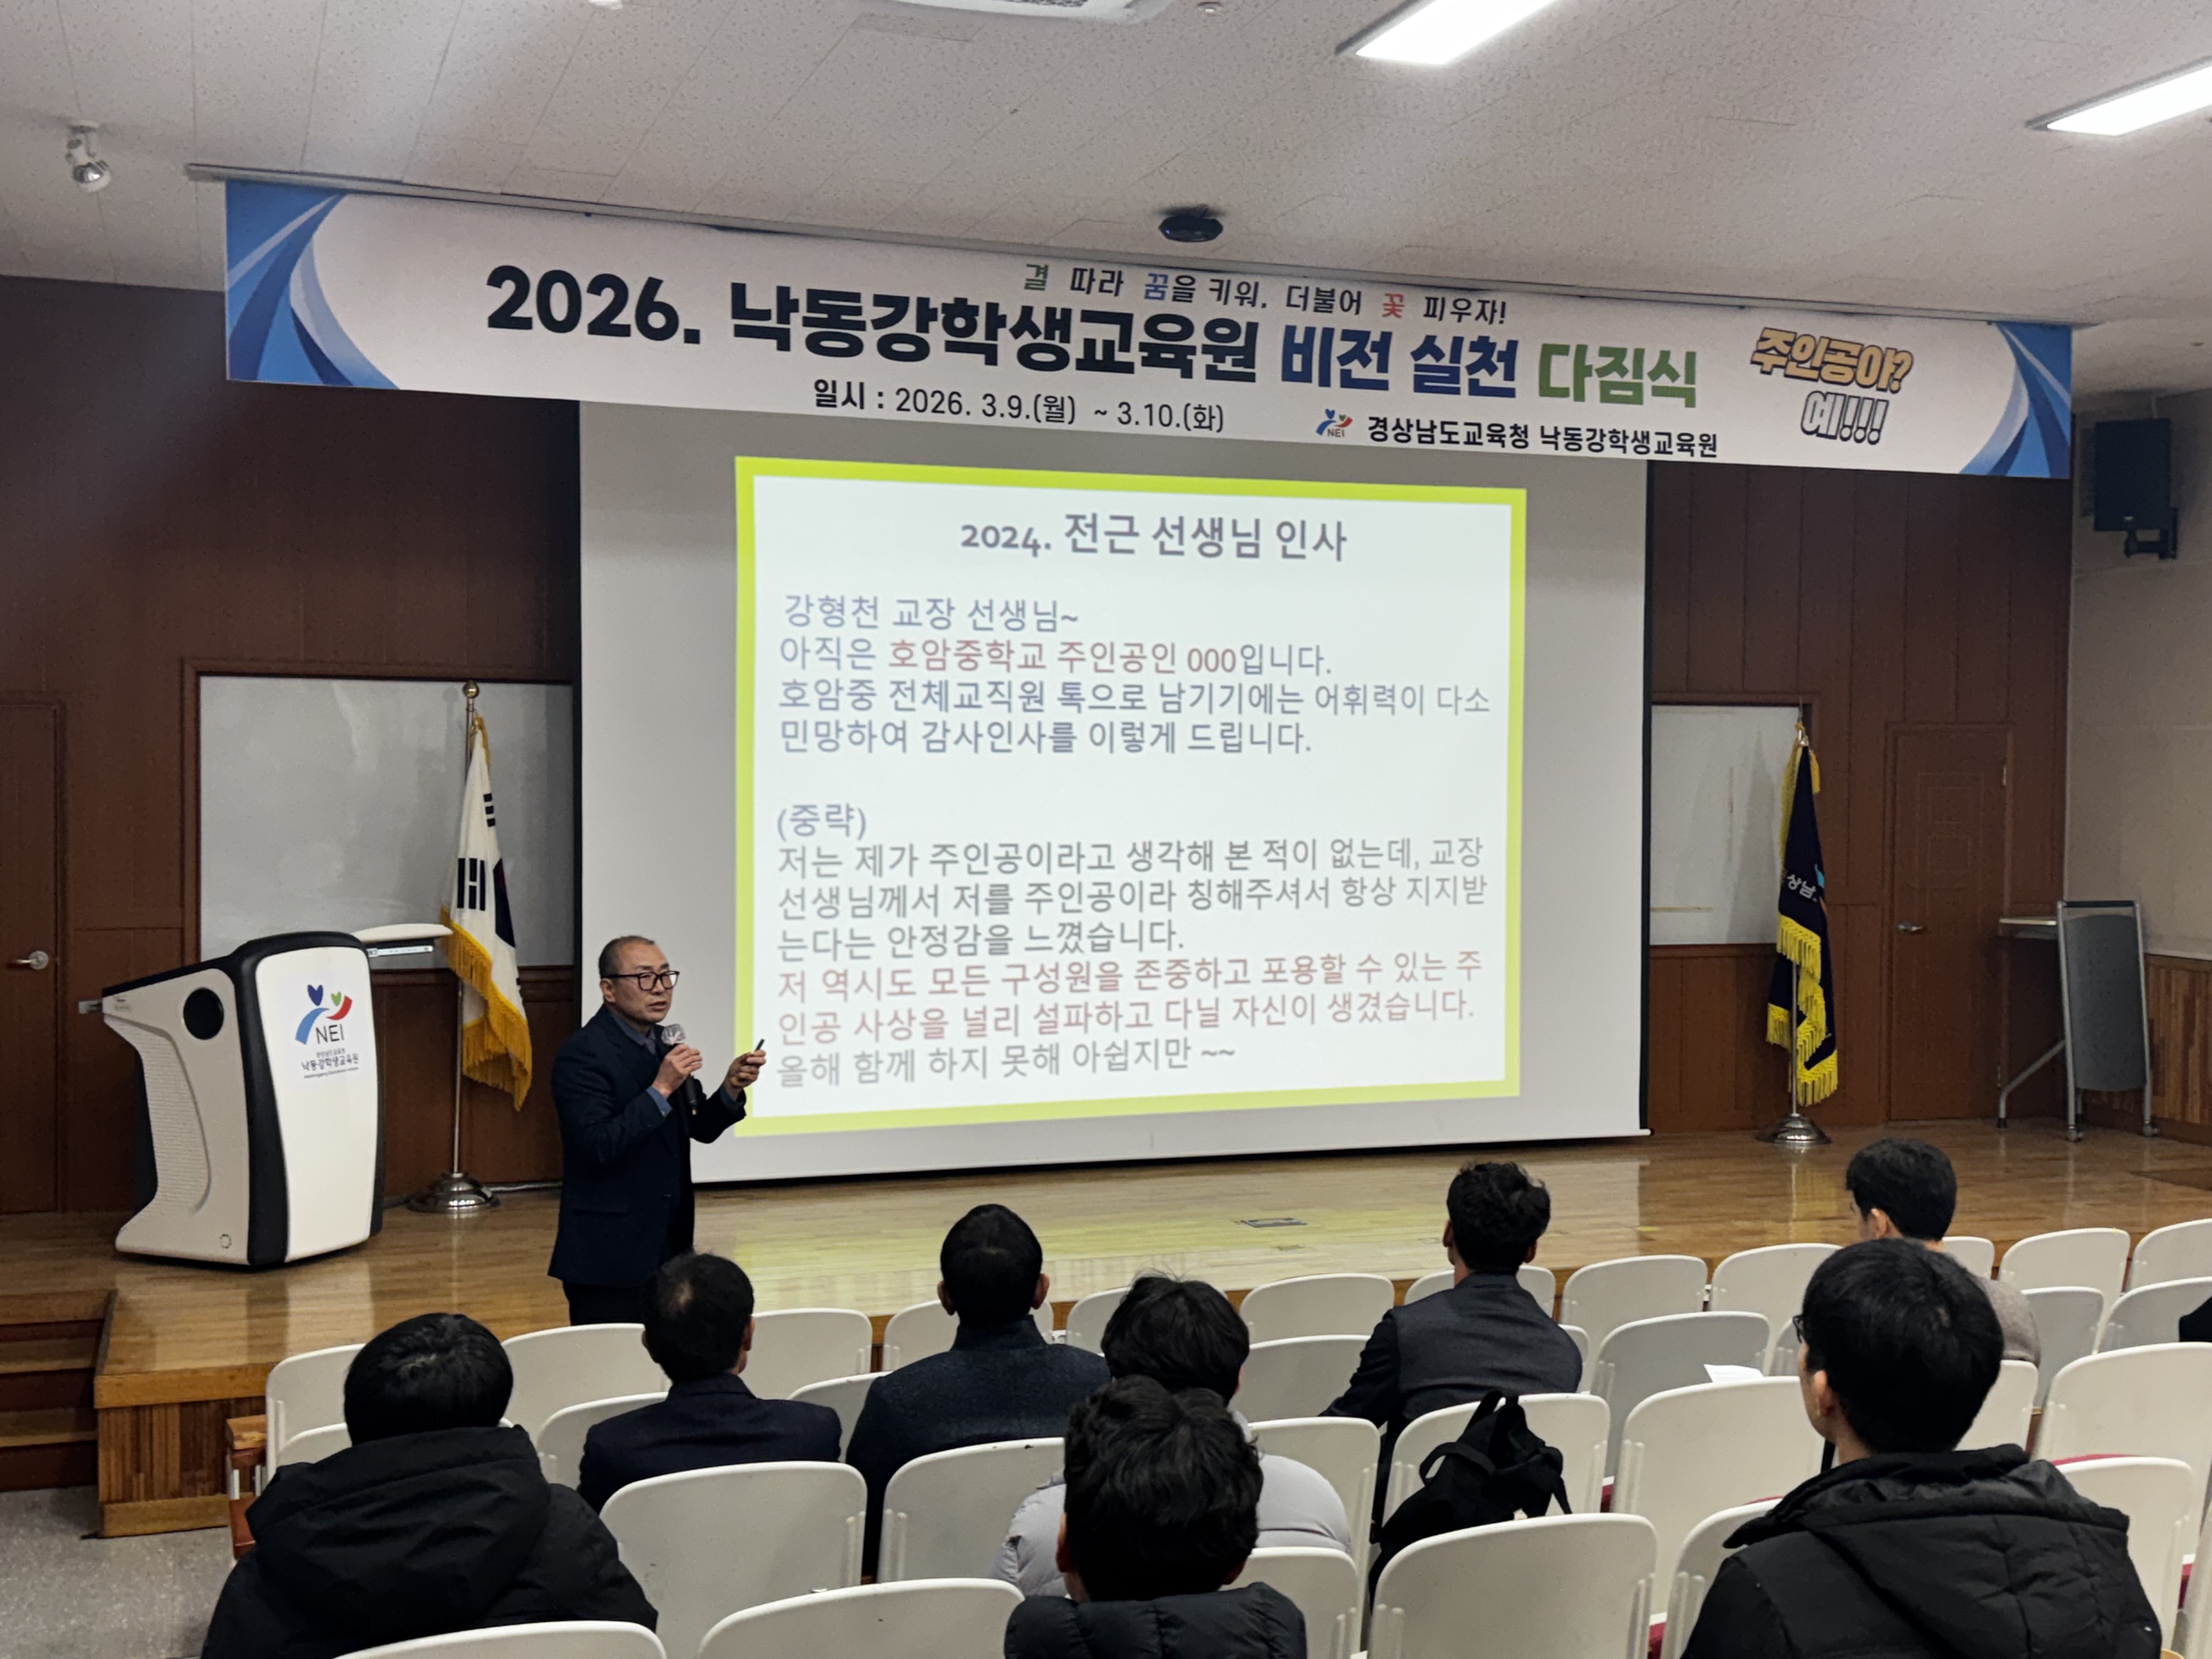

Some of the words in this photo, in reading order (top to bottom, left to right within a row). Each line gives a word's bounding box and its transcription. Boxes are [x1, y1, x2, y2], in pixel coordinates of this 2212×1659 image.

[1024, 263, 1049, 291] 결
[1070, 267, 1124, 297] 따라
[1144, 273, 1196, 303] 꿈을
[1286, 285, 1362, 315] 더불어
[1382, 292, 1405, 319] 꽃
[1423, 296, 1506, 325] 피우자!
[486, 264, 701, 345] 2026.
[730, 281, 1259, 383] 낙동강학생교육원
[1281, 325, 1390, 392] 비전
[1409, 334, 1519, 398] 실천
[1538, 342, 1697, 409] 다짐식
[1751, 327, 1913, 393] 주인공야?
[814, 379, 865, 410] 일시
[895, 387, 970, 416] 2026.
[981, 393, 1075, 425] 3.9.(월)
[1118, 401, 1223, 433] 3.10.(화)
[1800, 390, 1889, 445] 예!!!
[1327, 428, 1345, 438] NEI
[1367, 416, 1530, 450] 경상남도교육청
[1540, 426, 1718, 459] 낙동강학생교육원
[961, 524, 1051, 558] 2024.
[1064, 512, 1140, 555] 전근
[1152, 515, 1260, 559] 선생님
[1276, 520, 1347, 562] 인사
[785, 594, 878, 629] 강형천
[892, 597, 956, 630] 교장
[967, 599, 1079, 633] 선생님~
[780, 636, 877, 671] 아직은
[888, 638, 1047, 673] 호암중학교
[1057, 641, 1176, 674] 주인공인
[778, 678, 877, 712] 호암중
[889, 679, 1045, 714] 전체교직원
[1057, 681, 1147, 714] 톡으로
[1160, 682, 1304, 715] 남기기에는
[1315, 684, 1424, 716] 어휘력이
[1437, 685, 1490, 716] 다소
[781, 719, 907, 754] 민망하여
[922, 720, 1077, 754] 감사인사를
[1089, 721, 1175, 754] 이렇게
[1187, 721, 1311, 754] 드립니다.
[777, 803, 866, 842] (중략)
[778, 845, 843, 879] 저는
[855, 843, 919, 878] 제가
[929, 841, 1116, 877] 주인공이라고
[1126, 839, 1213, 873] 생각해
[1224, 840, 1252, 871] 본
[1262, 838, 1317, 871] 적이
[1330, 837, 1419, 871] 없는데,
[1429, 837, 1484, 868] 교장
[778, 883, 939, 921] 선생님께서
[953, 883, 1014, 917] 저를
[1024, 879, 1177, 916] 주인공이라
[1187, 877, 1329, 911] 칭해주셔서
[1341, 876, 1397, 907] 항상
[1406, 874, 1488, 907] 지지받
[777, 927, 876, 962] 는다는
[888, 923, 1014, 959] 안정감을
[1024, 919, 1184, 955] 느꼈습니다.
[778, 969, 805, 1004] 저
[822, 967, 917, 1003] 역시도
[928, 964, 991, 997] 모든
[1001, 961, 1124, 997] 구성원을
[1133, 957, 1251, 991] 존중하고
[1261, 953, 1347, 985] 포용할
[1356, 953, 1383, 984] 수
[1394, 951, 1447, 983] 있는
[1456, 951, 1482, 981] 주
[315, 1024, 345, 1044] NEI
[778, 1011, 842, 1046] 인공
[854, 1007, 950, 1043] 사상을
[963, 1003, 1019, 1039] 널리
[1033, 1000, 1154, 1036] 설파하고
[1165, 996, 1220, 1030] 다닐
[1232, 993, 1316, 1028] 자신이
[1327, 988, 1474, 1023] 생겼습니다.
[776, 1052, 840, 1088] 올해
[853, 1048, 915, 1085] 함께
[928, 1045, 987, 1081] 하지
[1001, 1042, 1059, 1078] 못해
[1073, 1036, 1192, 1074] 아쉽지만
